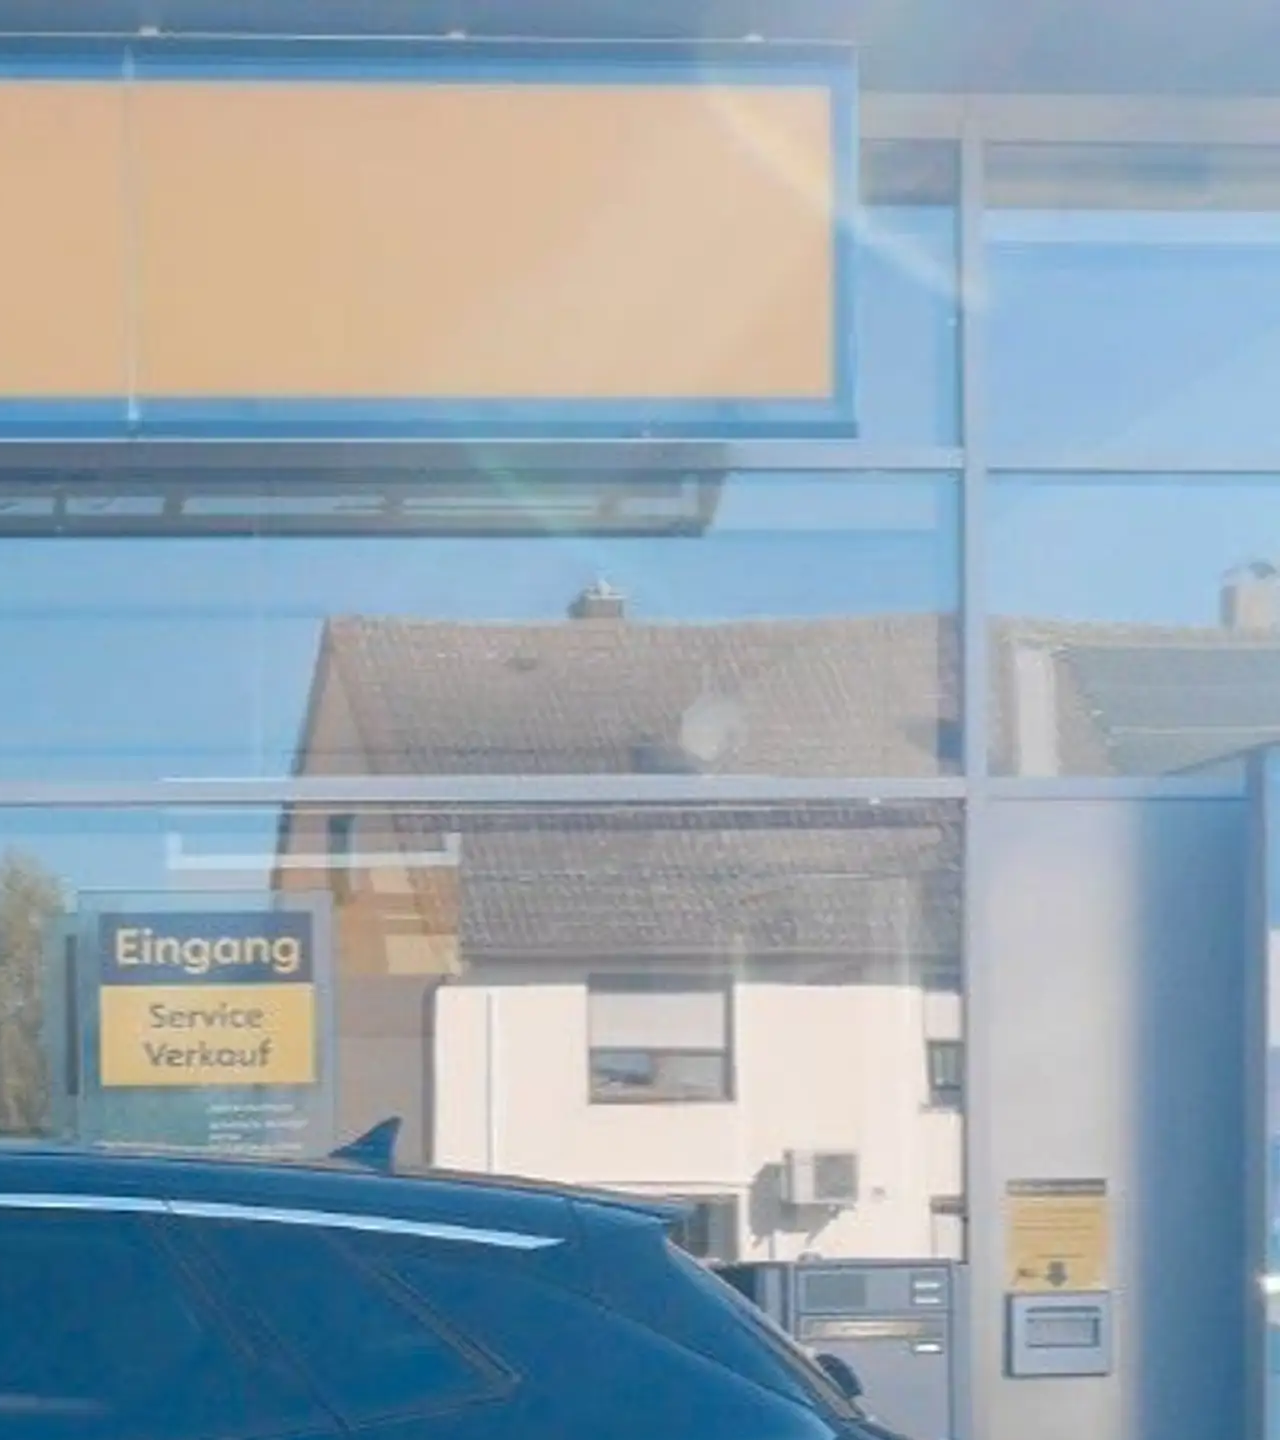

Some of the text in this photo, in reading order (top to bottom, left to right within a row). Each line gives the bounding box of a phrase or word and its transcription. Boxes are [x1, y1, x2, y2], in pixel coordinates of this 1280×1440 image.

[115, 927, 301, 974] Eingang
[148, 1002, 265, 1029] Service
[142, 1037, 273, 1068] Verkauf
